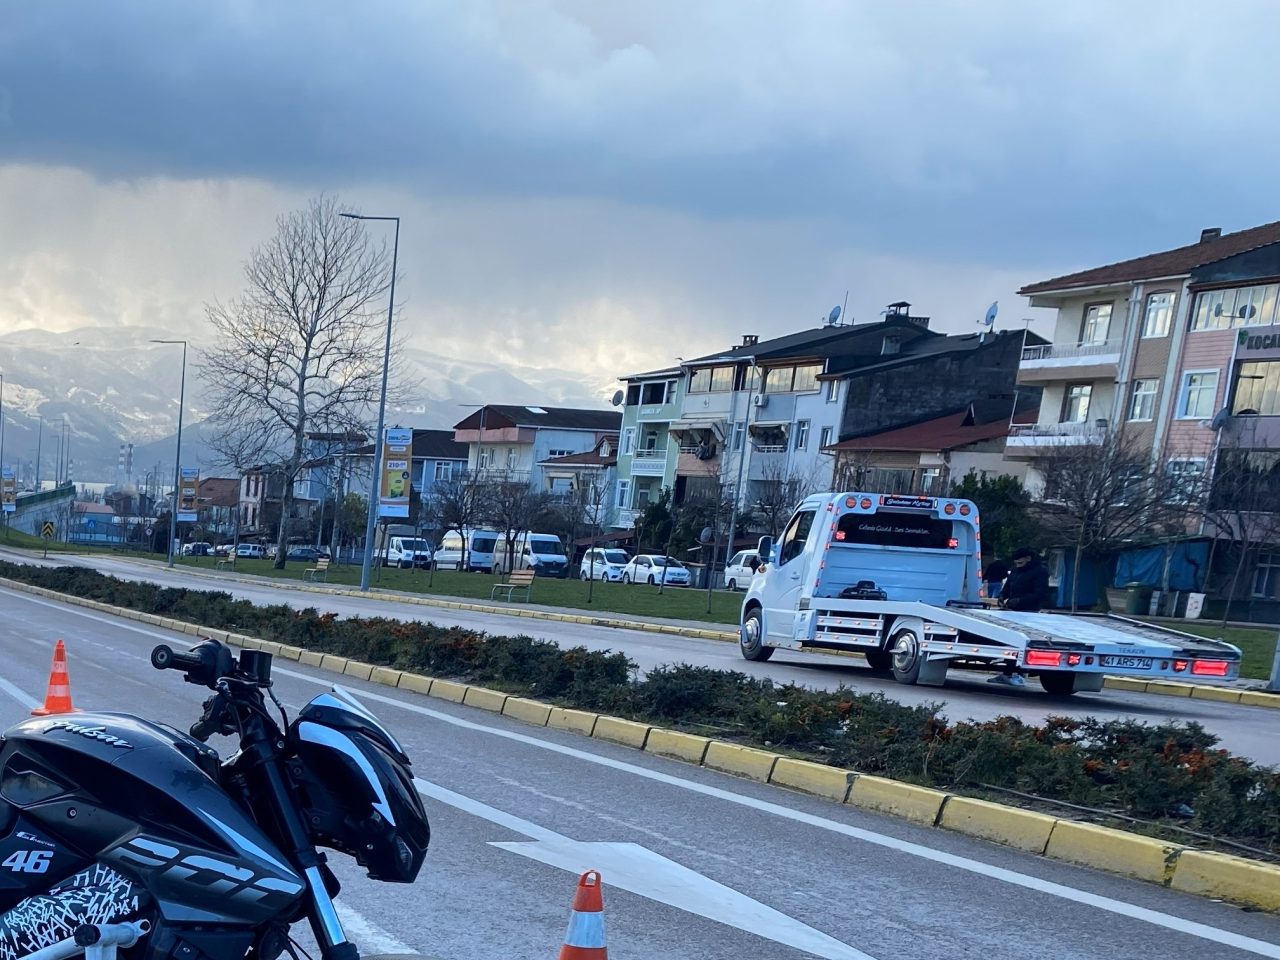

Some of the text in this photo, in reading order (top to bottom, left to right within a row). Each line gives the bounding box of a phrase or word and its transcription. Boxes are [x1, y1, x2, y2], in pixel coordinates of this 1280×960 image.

[1247, 333, 1280, 350] KOCA
[1104, 655, 1151, 668] 41 ARS 714
[43, 721, 134, 749] Pulsar
[2, 850, 54, 873] 46
